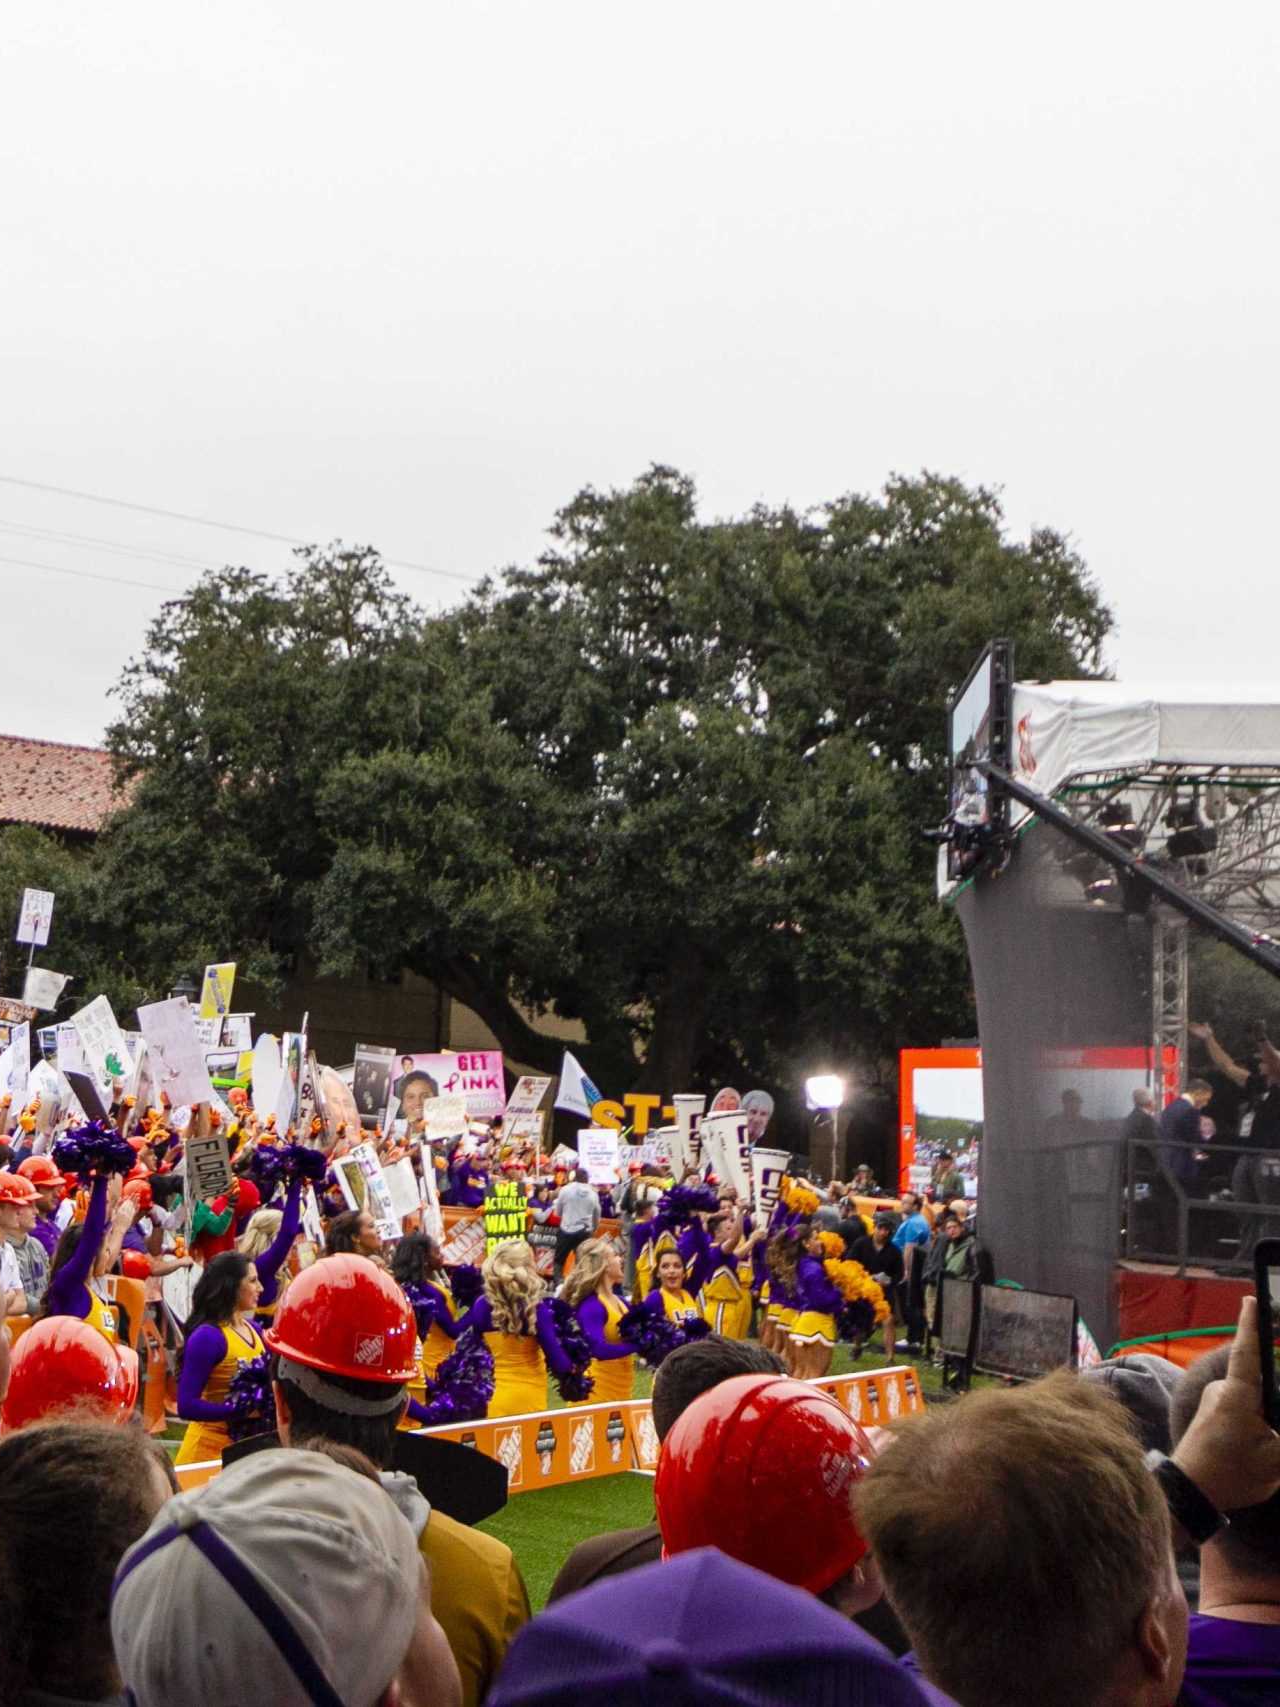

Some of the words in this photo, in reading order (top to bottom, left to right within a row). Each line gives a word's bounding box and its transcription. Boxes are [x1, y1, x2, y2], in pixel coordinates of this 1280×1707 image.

[458, 1054, 489, 1071] GET
[494, 1182, 519, 1197] WE
[484, 1196, 528, 1212] ACTUALLY
[485, 1213, 527, 1233] WANT
